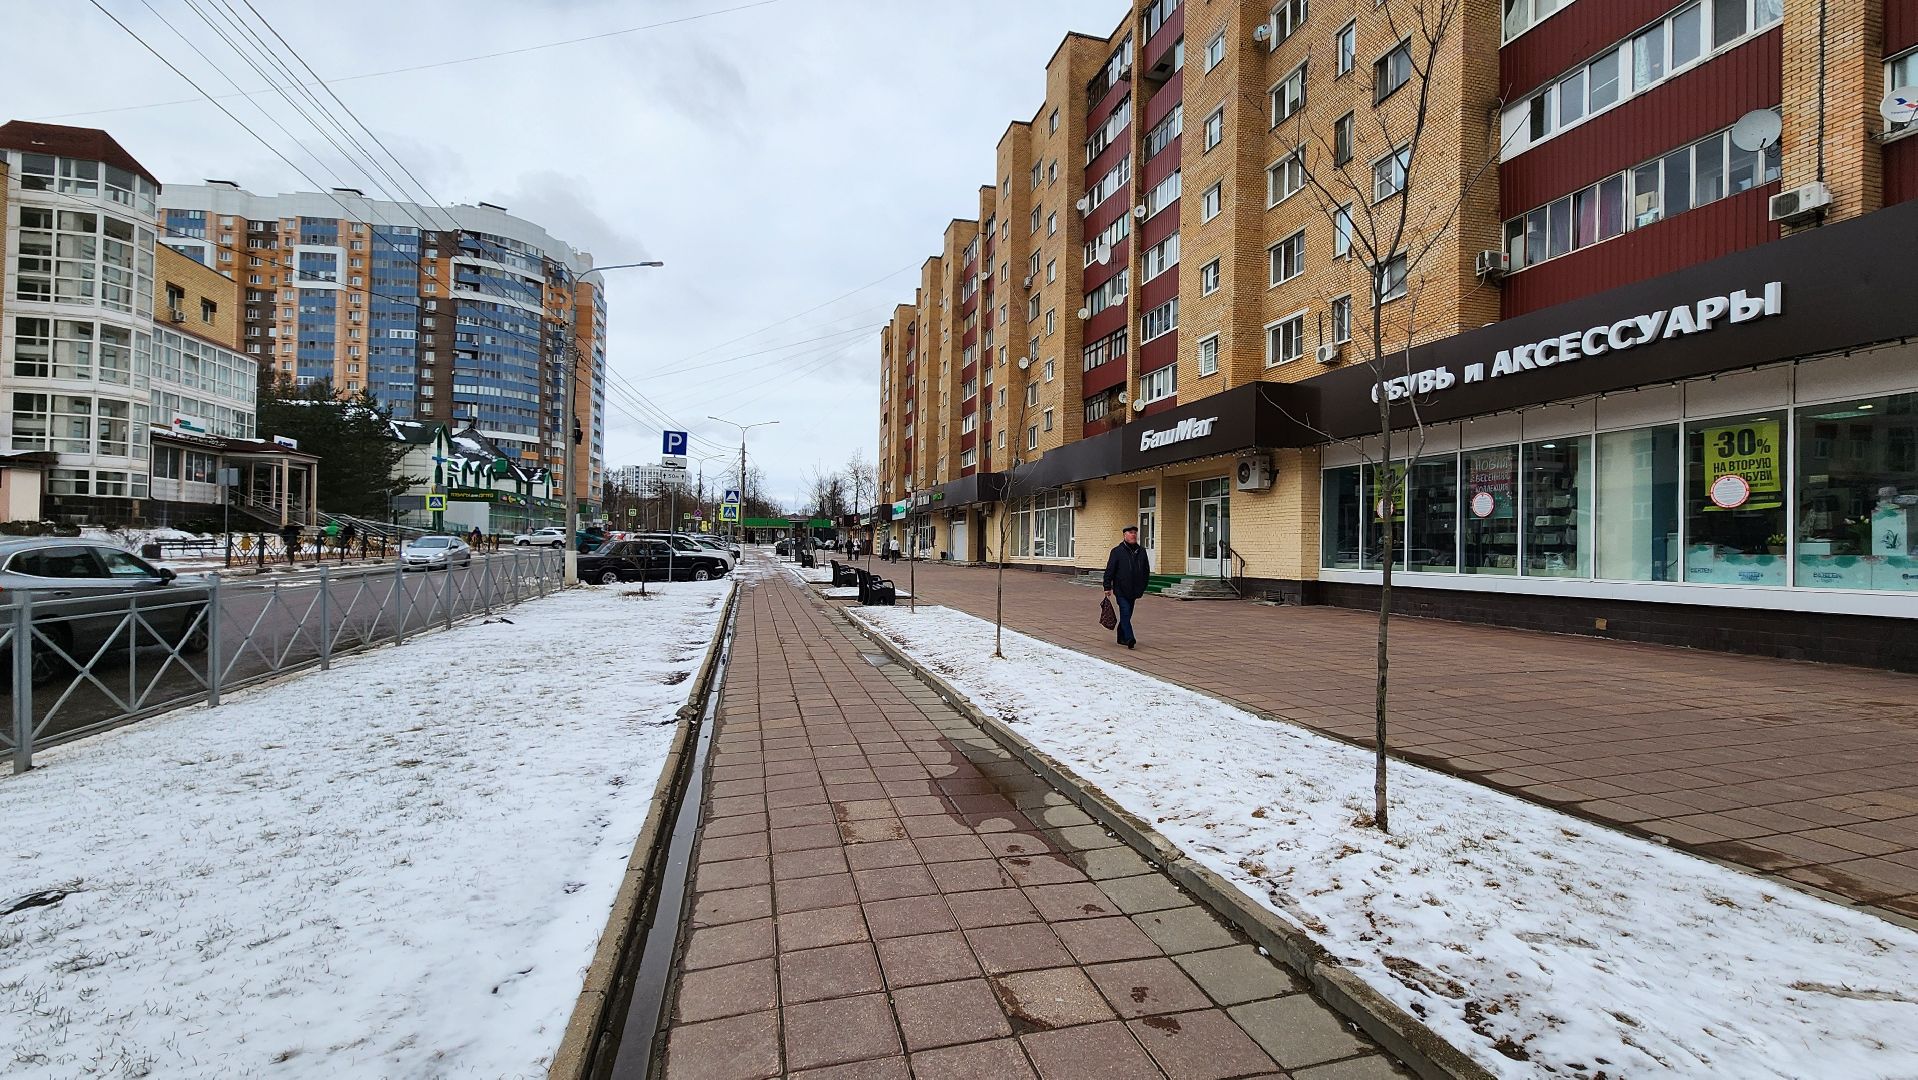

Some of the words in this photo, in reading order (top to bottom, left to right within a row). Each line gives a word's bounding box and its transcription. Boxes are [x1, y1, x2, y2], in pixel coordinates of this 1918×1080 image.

[1464, 360, 1484, 384] и
[1490, 281, 1782, 378] АКСЕССУАРЫ
[668, 432, 683, 453] P
[1140, 416, 1219, 452] БашМаг
[1713, 428, 1771, 459] -30%
[1713, 461, 1727, 474] НА
[1728, 457, 1772, 471] ВТОРУЮ
